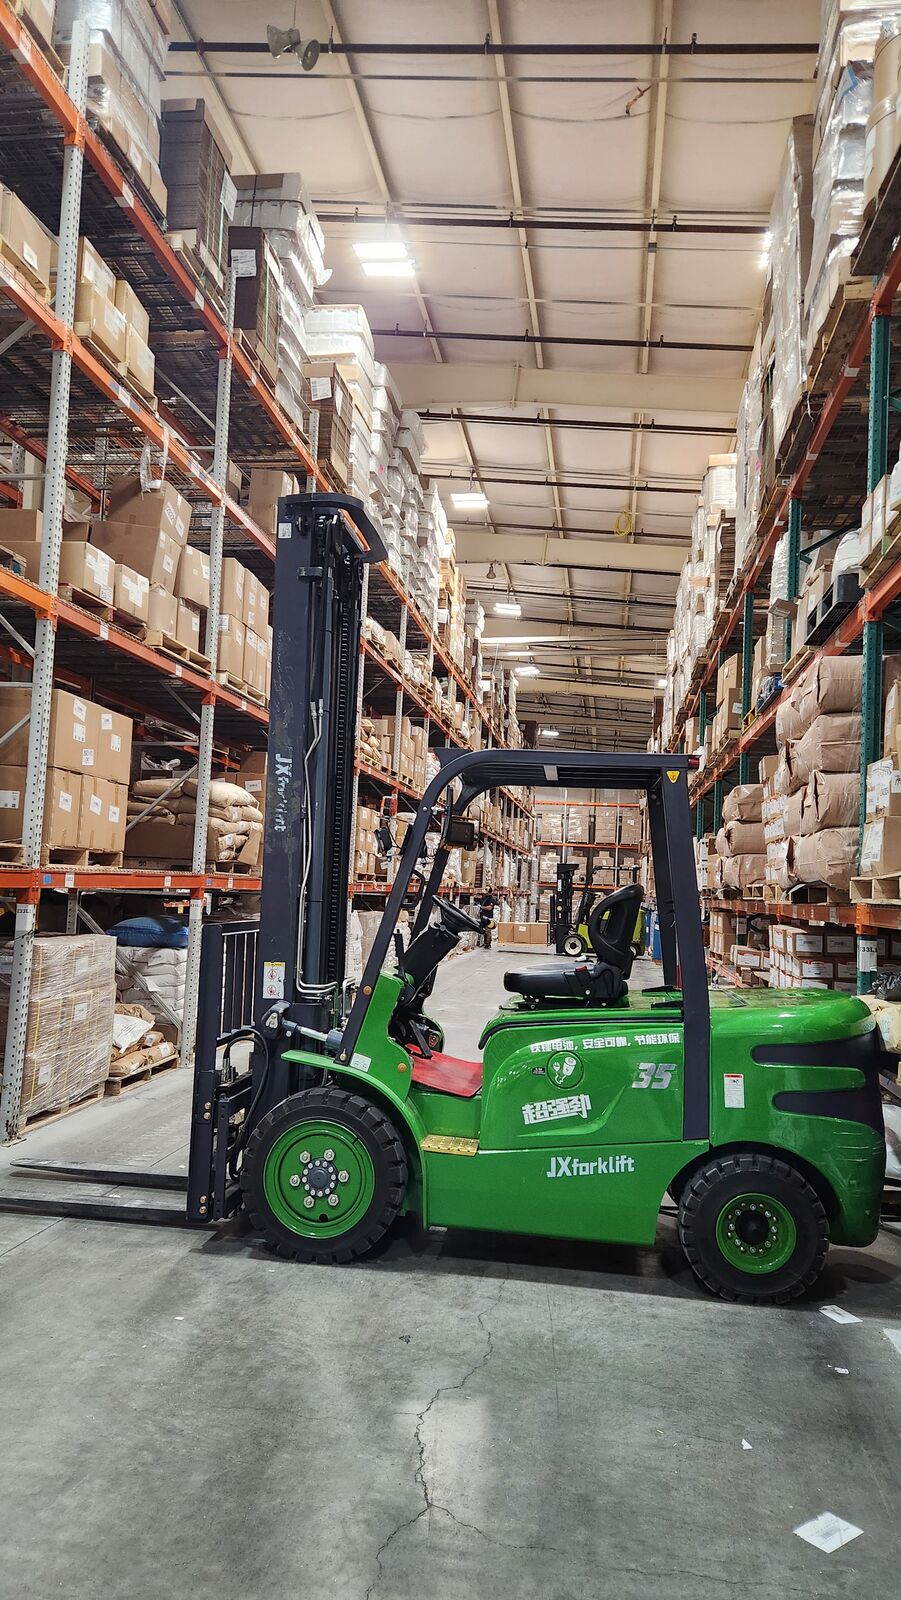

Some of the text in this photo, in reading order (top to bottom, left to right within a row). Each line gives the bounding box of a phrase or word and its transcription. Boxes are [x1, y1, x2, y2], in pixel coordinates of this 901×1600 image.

[631, 1063, 676, 1089] 35
[522, 1094, 592, 1125] 超强劲
[546, 1155, 635, 1178] JXforklift
